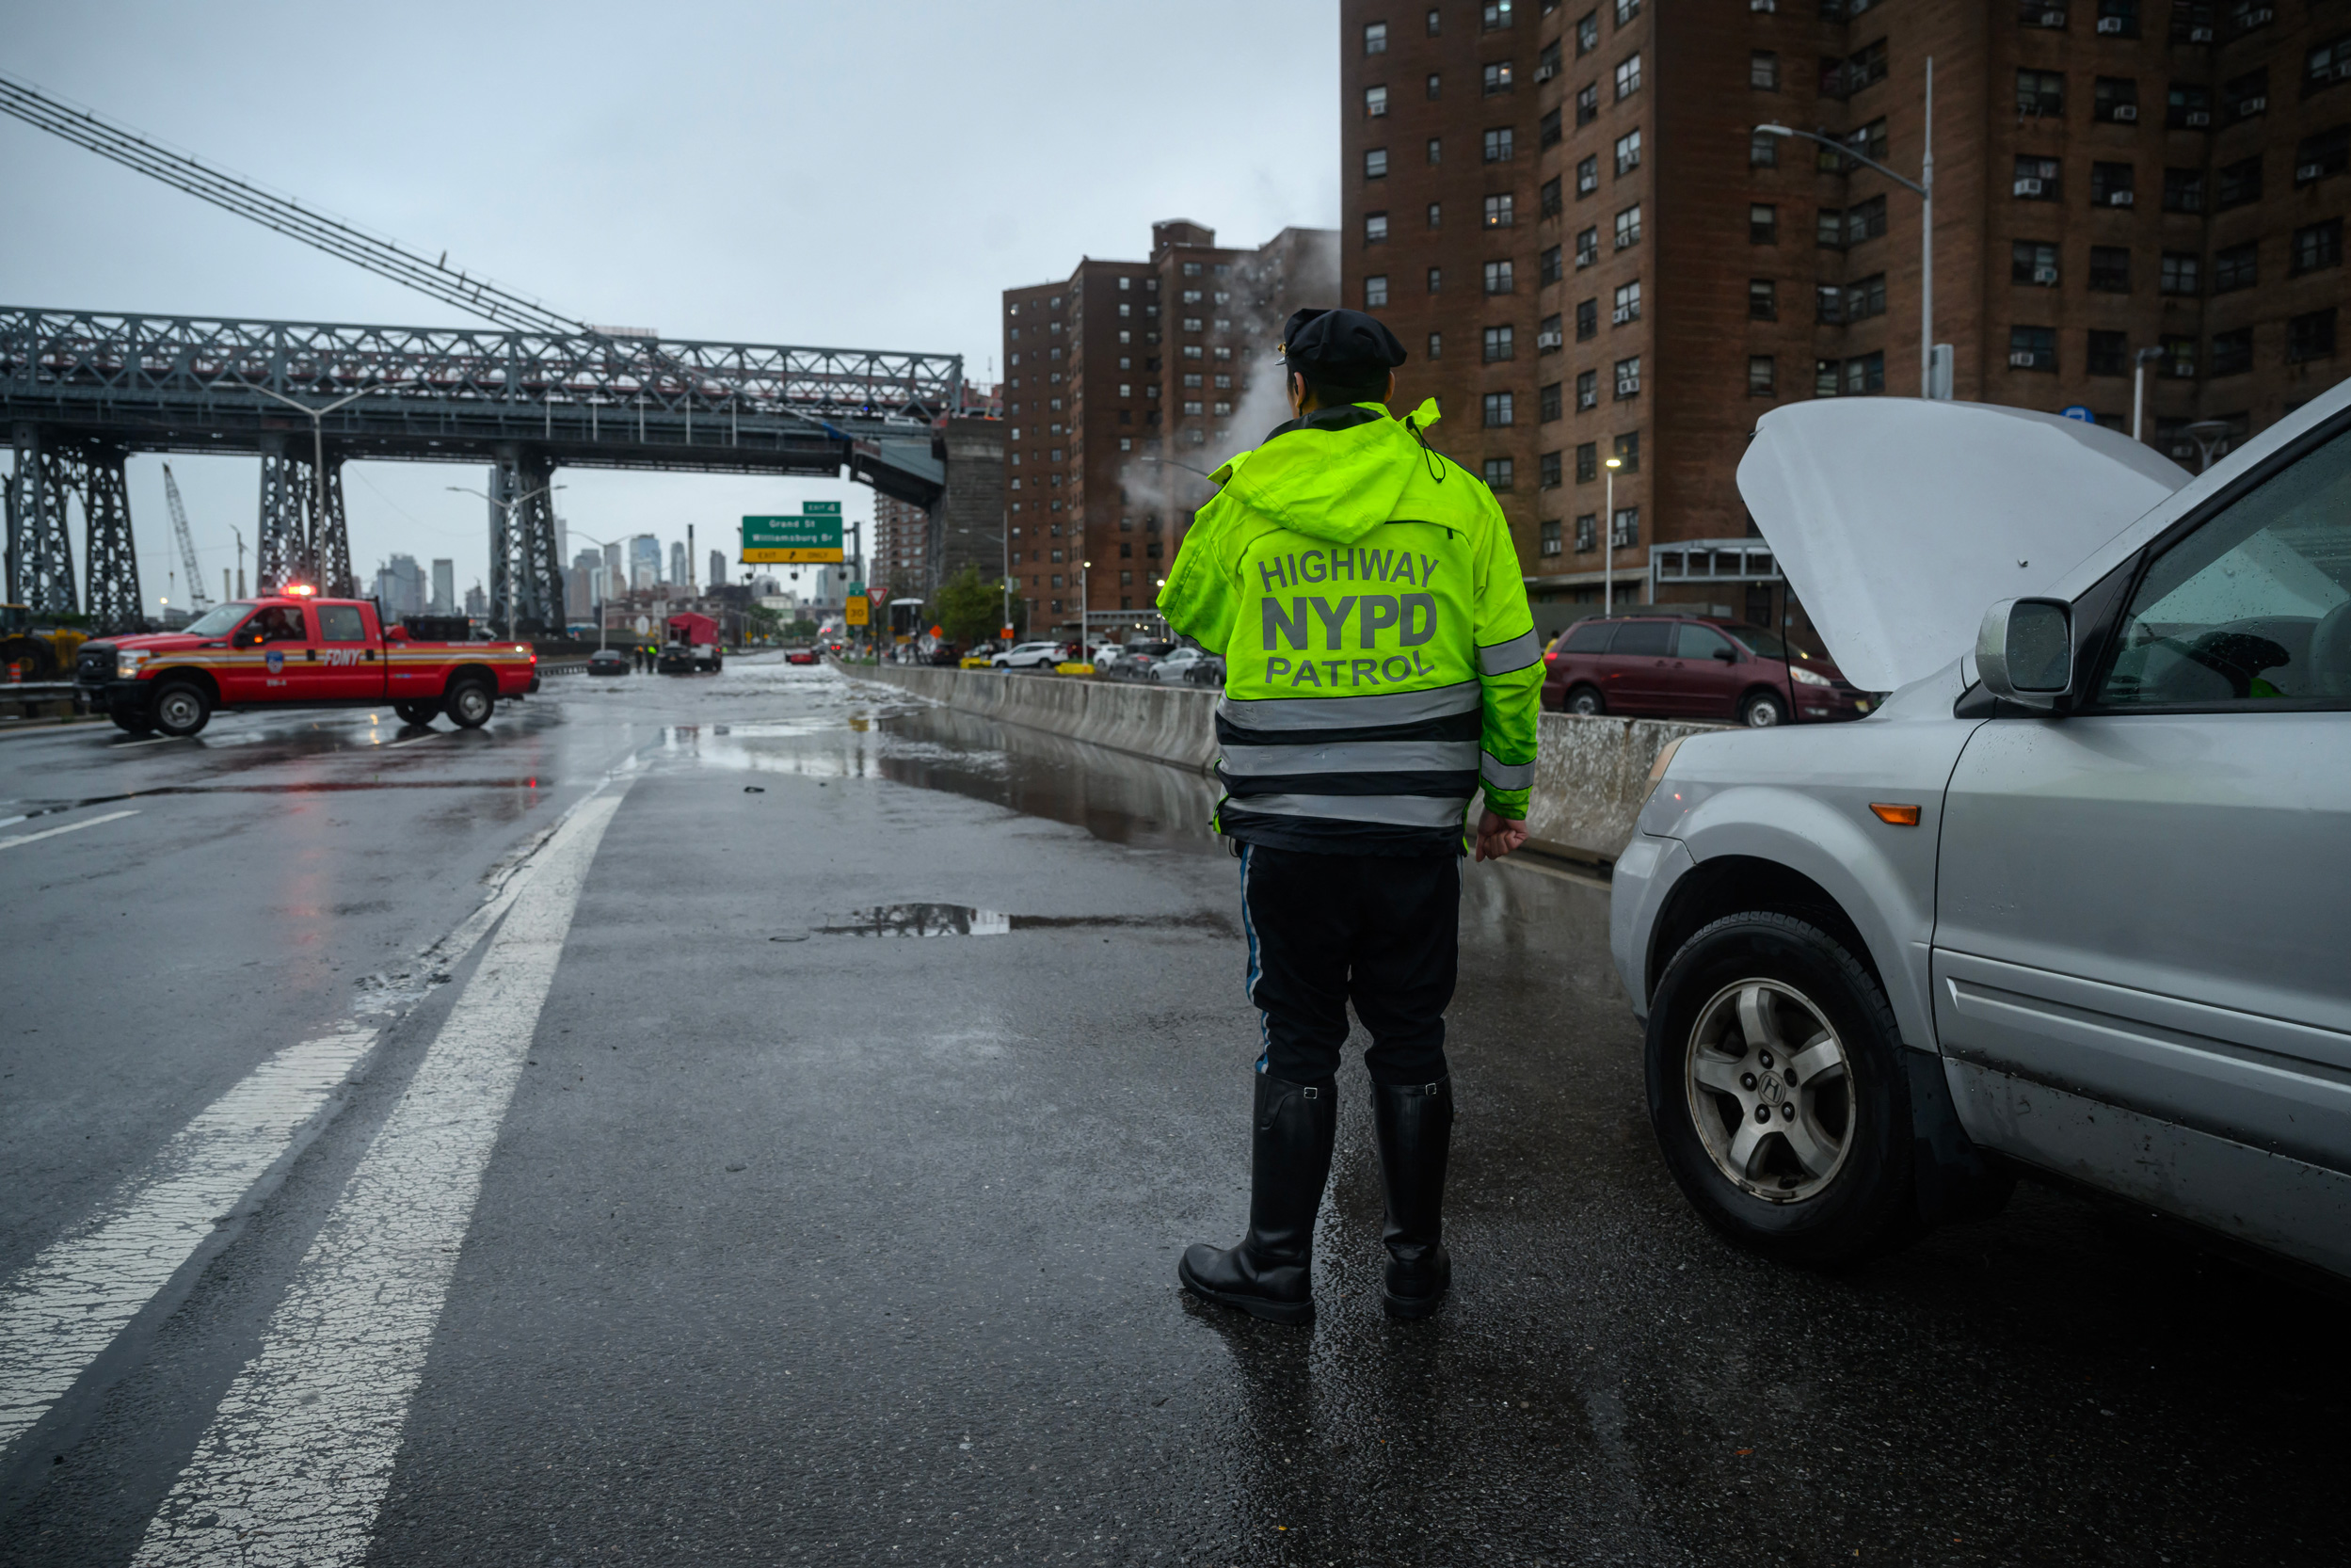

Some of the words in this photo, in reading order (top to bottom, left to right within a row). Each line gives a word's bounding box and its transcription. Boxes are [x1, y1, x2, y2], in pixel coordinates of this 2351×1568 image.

[769, 520, 800, 528] Grand
[805, 520, 816, 528] St
[752, 534, 818, 544] Williamsburg
[821, 534, 834, 542] Br
[1257, 548, 1440, 593] HIGHWAY
[1261, 592, 1438, 651] NYPD
[323, 648, 361, 666] FDNY
[1265, 649, 1435, 688] PATROL
